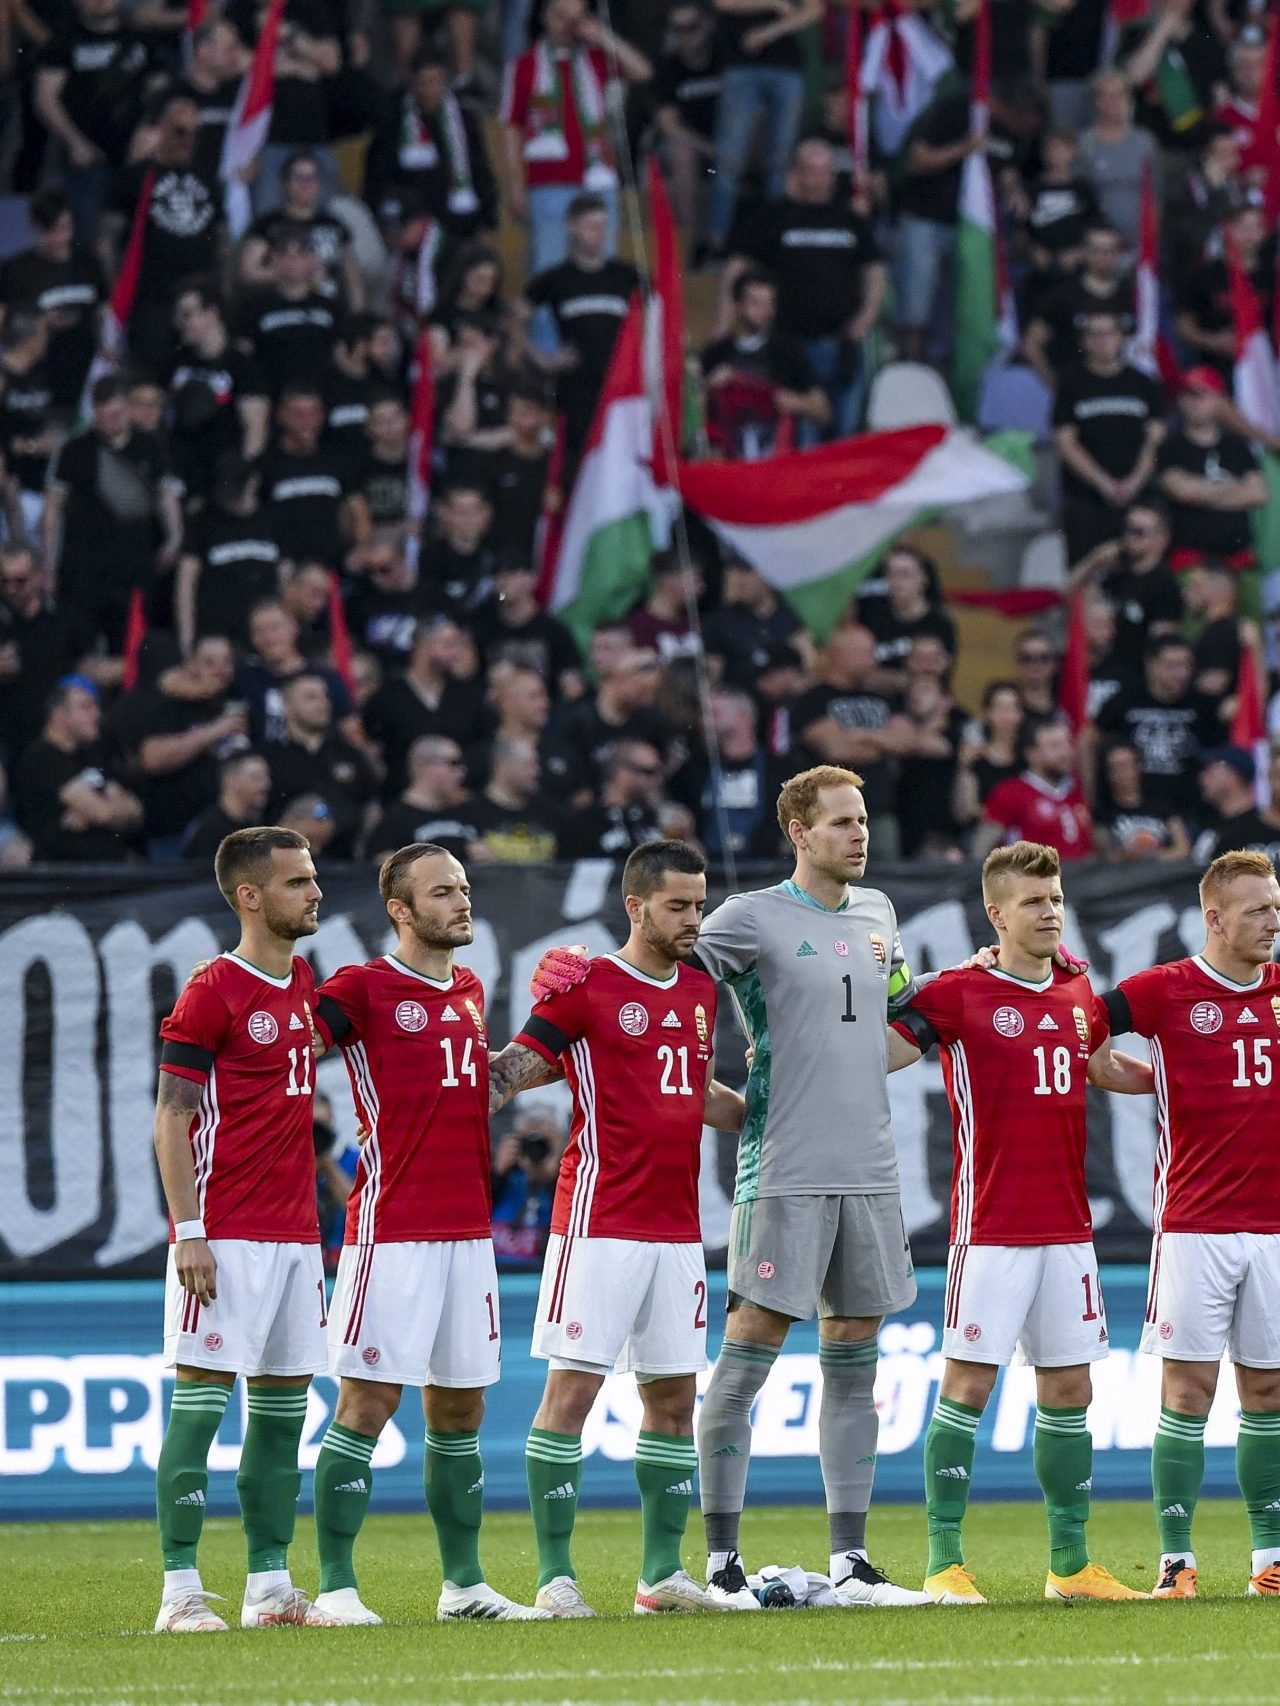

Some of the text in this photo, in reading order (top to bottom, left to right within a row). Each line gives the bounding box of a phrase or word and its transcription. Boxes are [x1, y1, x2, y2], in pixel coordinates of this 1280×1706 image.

[841, 974, 856, 1022] 1
[286, 1045, 312, 1095] 11
[440, 1037, 477, 1087] 14
[657, 1044, 693, 1095] 21
[1033, 1046, 1071, 1095] 18
[1232, 1038, 1272, 1088] 15
[935, 1470, 971, 1480] adidas
